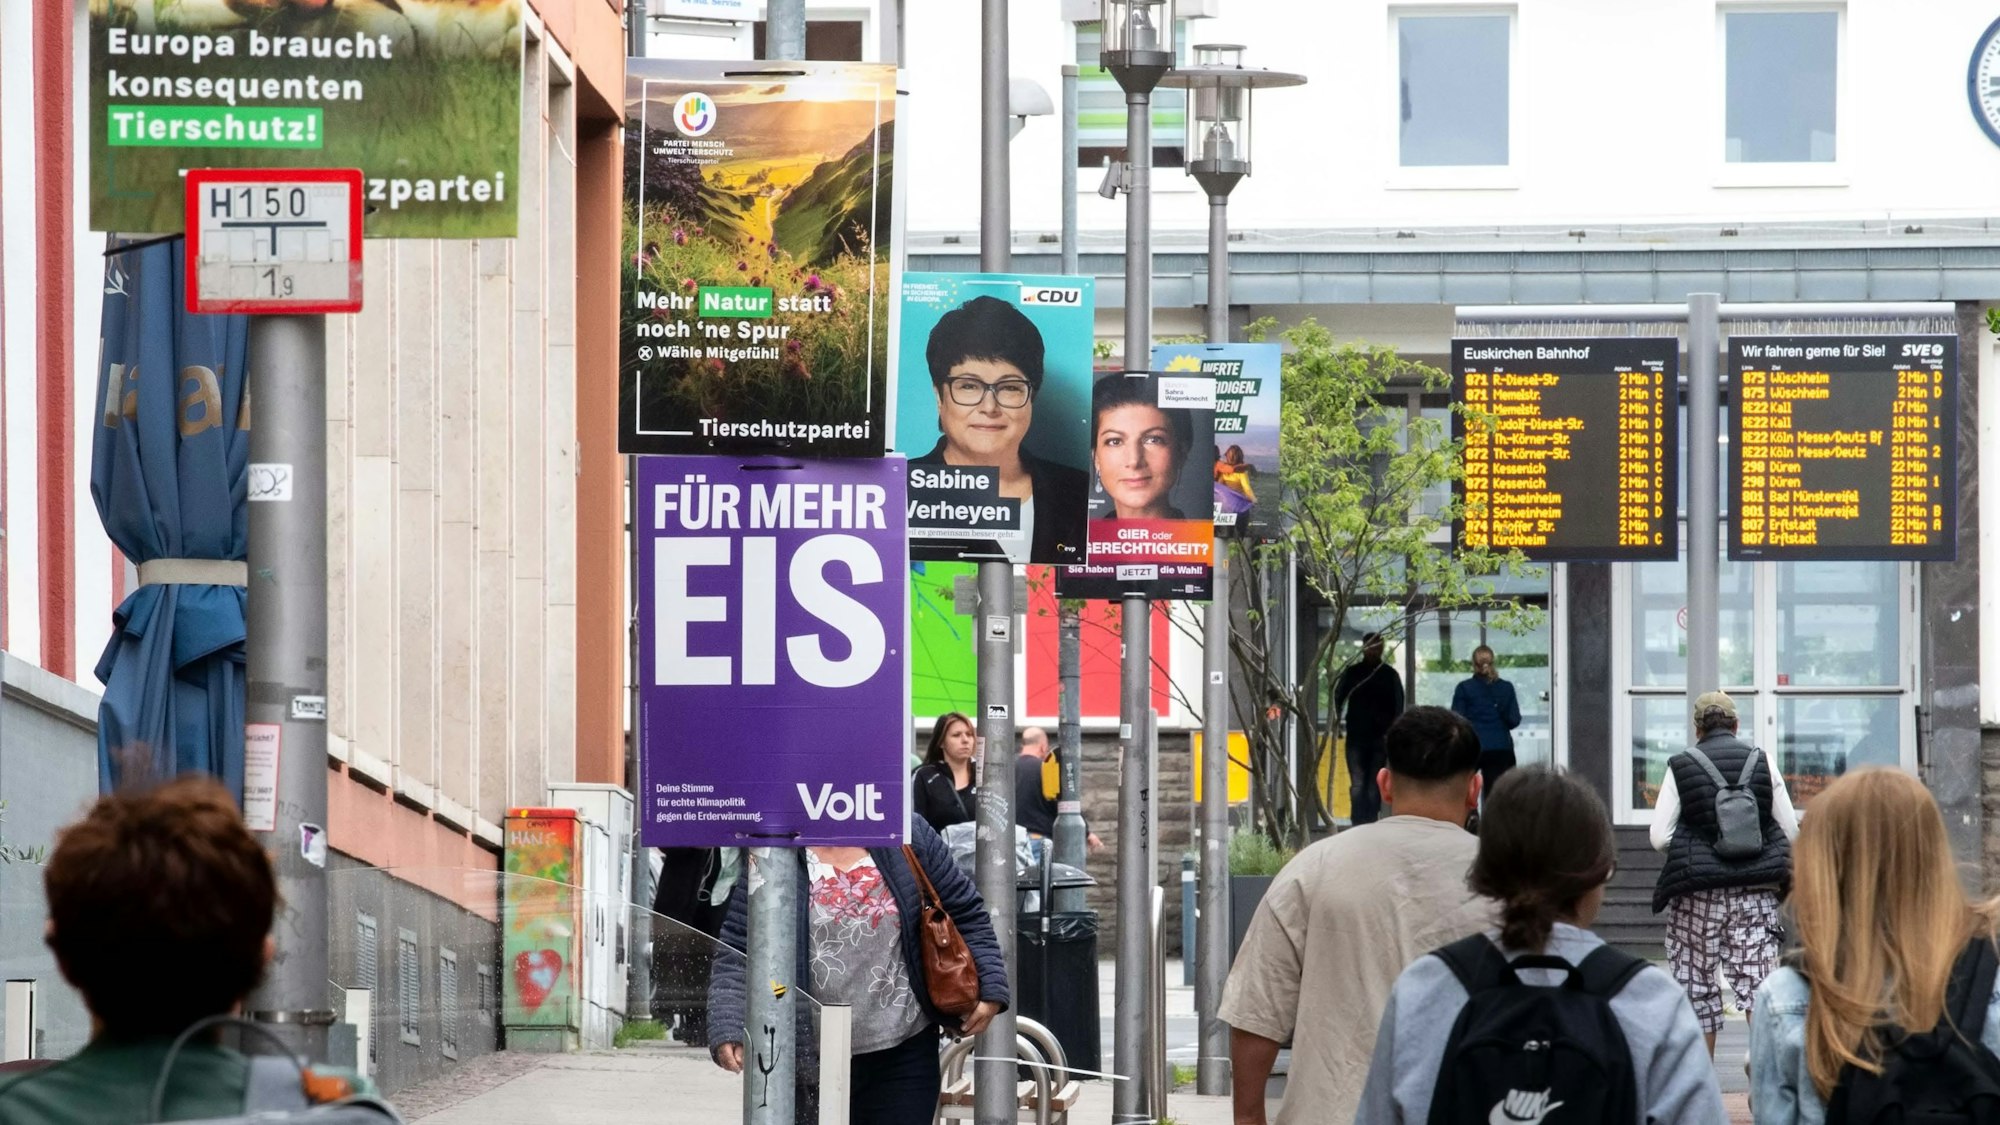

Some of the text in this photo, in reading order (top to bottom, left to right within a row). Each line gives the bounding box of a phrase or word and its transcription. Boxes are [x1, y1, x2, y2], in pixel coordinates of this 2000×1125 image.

[108, 28, 392, 64] Europa braucht
[108, 70, 363, 106] konsequenten
[113, 111, 318, 142] Tierschutz!
[663, 140, 725, 148] PARTEI MENSCH
[653, 147, 734, 156] UMWELT TIERSCHUTZ
[668, 157, 719, 165] Tierschutzpartei
[637, 291, 831, 312] Mehr Natur statt
[1037, 290, 1079, 303] CDU
[637, 321, 690, 338] noch
[737, 321, 790, 343] Spur
[657, 345, 779, 362] Wähle Mitgefühl!
[1464, 346, 1591, 360] Euskirchen Bahnhof
[1741, 344, 1931, 360] Wir fahren gerne für Sie! SVE
[1202, 362, 1240, 376] WERTE
[1465, 372, 1488, 385] 871
[1629, 372, 1648, 385] Min
[1742, 370, 1927, 383] 875 Wüschheim Min
[1465, 387, 1648, 399] 871 Memelstr. Min
[1742, 385, 1927, 398] 875 Wüschheim Min
[1493, 402, 1648, 414] Memelstr. Min
[1742, 400, 1927, 413] RE22 Kall 17 Min
[1629, 416, 1648, 429] Min
[1742, 415, 1927, 428] RE22 Kall 18 Min
[699, 418, 870, 443] Tierschutzpartei
[1629, 431, 1648, 444] Min
[1742, 430, 1927, 445] RE22 Köln Messe/Deutz Bf 20 Min
[1465, 446, 1488, 459] 872
[1629, 446, 1648, 459] Min
[1742, 445, 1927, 458] RE22 Köln Messe/Deutz 21 Min
[1465, 461, 1648, 473] 872 Kessenich Min
[1742, 459, 1927, 472] 298 Düren 22 Min
[910, 469, 990, 490] Sabine
[1465, 476, 1648, 488] 872 Kessenich Min
[1742, 474, 1927, 487] 298 Düren 22 Min
[654, 474, 887, 529] FÜR MEHR
[1493, 490, 1561, 503] Schweinheim
[1629, 490, 1648, 503] Min
[1742, 489, 1927, 504] 801 Bad Münstereifel 22 Min
[908, 500, 1011, 525] Verheyen
[1493, 505, 1648, 518] Schweinheim Min
[1742, 504, 1927, 519] 801 Bad Münstereifel 22 Min
[1465, 518, 1488, 531] 874
[1538, 518, 1554, 531] Str.
[1629, 518, 1648, 531] Min
[1742, 517, 1927, 532] 807 Erftstadt 22 Min
[1117, 529, 1173, 540] GIER oder
[1493, 532, 1546, 544] Kirchheim
[1629, 532, 1648, 544] Min
[1742, 531, 1927, 546] 807 Erftstadt 22 Min
[1068, 565, 1203, 577] Sie haben JETZT die Wahl!
[654, 534, 886, 687] EIS
[656, 784, 714, 793] Deine Stimme
[657, 797, 746, 809] für echte Klimapolitik
[796, 783, 885, 822] Volt
[656, 812, 763, 823] gegen die Erderwärmung.
